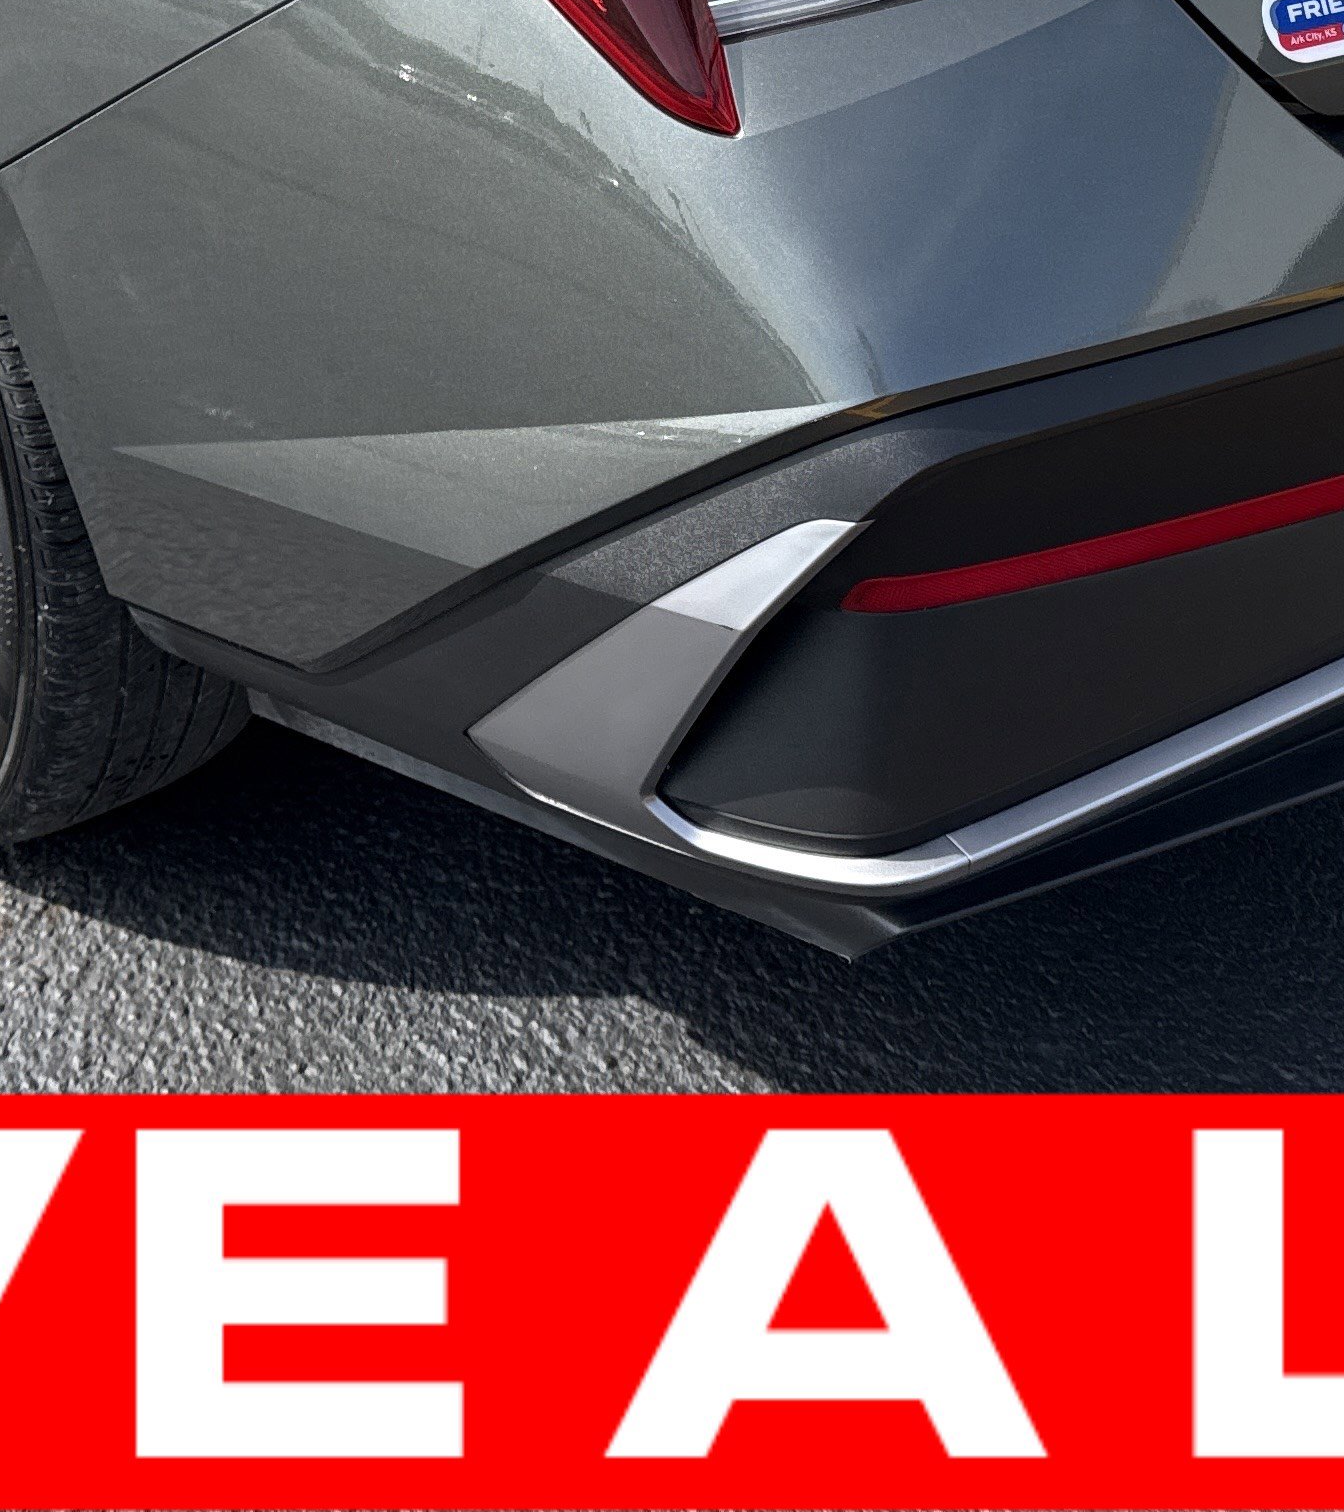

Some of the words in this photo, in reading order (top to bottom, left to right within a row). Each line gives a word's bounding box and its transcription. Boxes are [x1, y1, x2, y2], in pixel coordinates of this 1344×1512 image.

[1290, 35, 1305, 46] Ark
[1306, 30, 1325, 43] City,
[1324, 27, 1337, 38] KS
